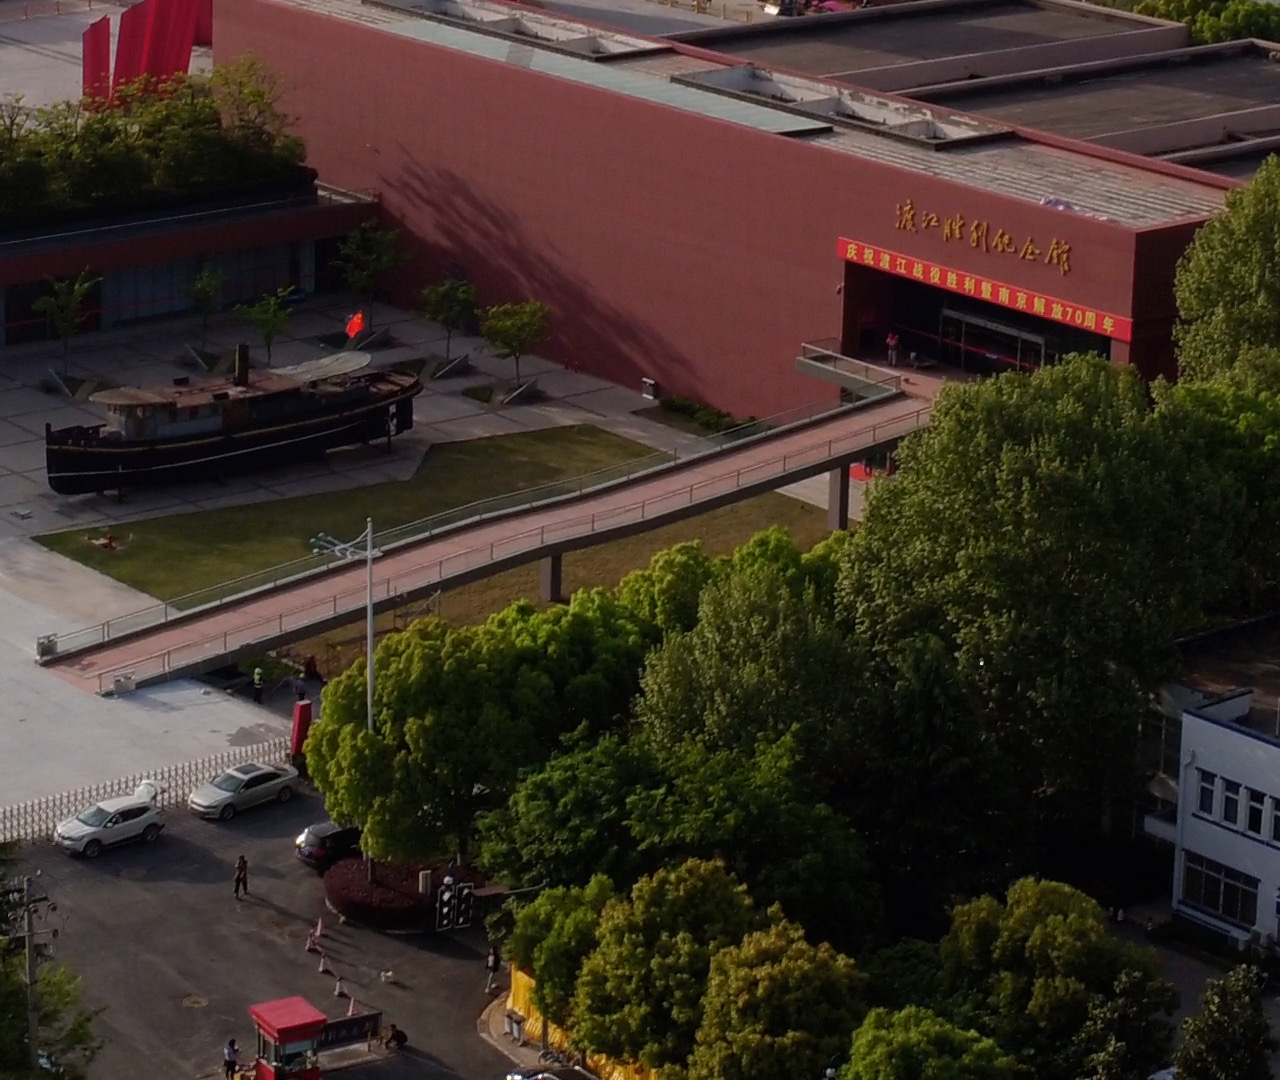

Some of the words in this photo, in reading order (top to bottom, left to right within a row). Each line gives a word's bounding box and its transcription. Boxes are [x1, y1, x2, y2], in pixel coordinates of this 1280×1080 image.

[895, 199, 1072, 276] 渡江胜利纪念馆
